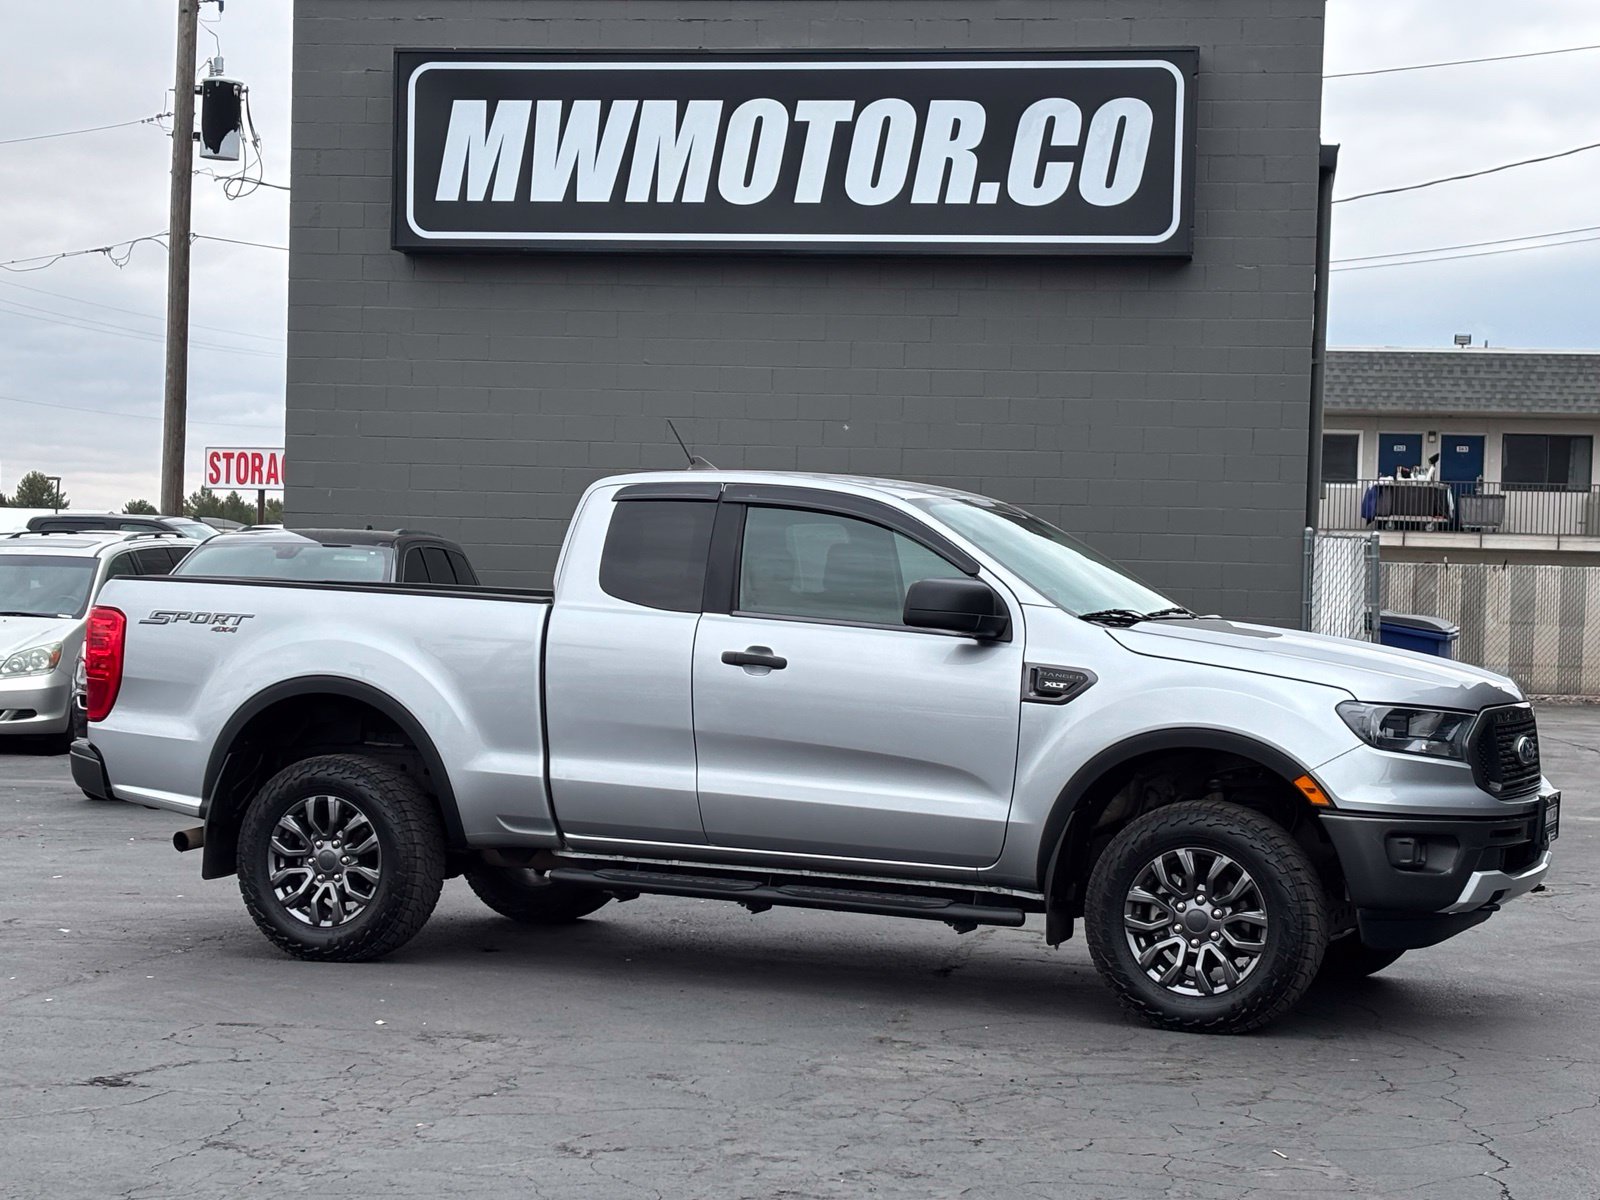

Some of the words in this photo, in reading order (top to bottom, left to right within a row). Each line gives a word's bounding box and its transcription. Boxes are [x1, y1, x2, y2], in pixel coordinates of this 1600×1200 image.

[435, 98, 1153, 207] MWMOTOR.CO
[209, 451, 286, 485] STORA
[139, 610, 255, 626] SPORT
[1041, 671, 1084, 681] RANGER
[1044, 681, 1067, 689] XLT
